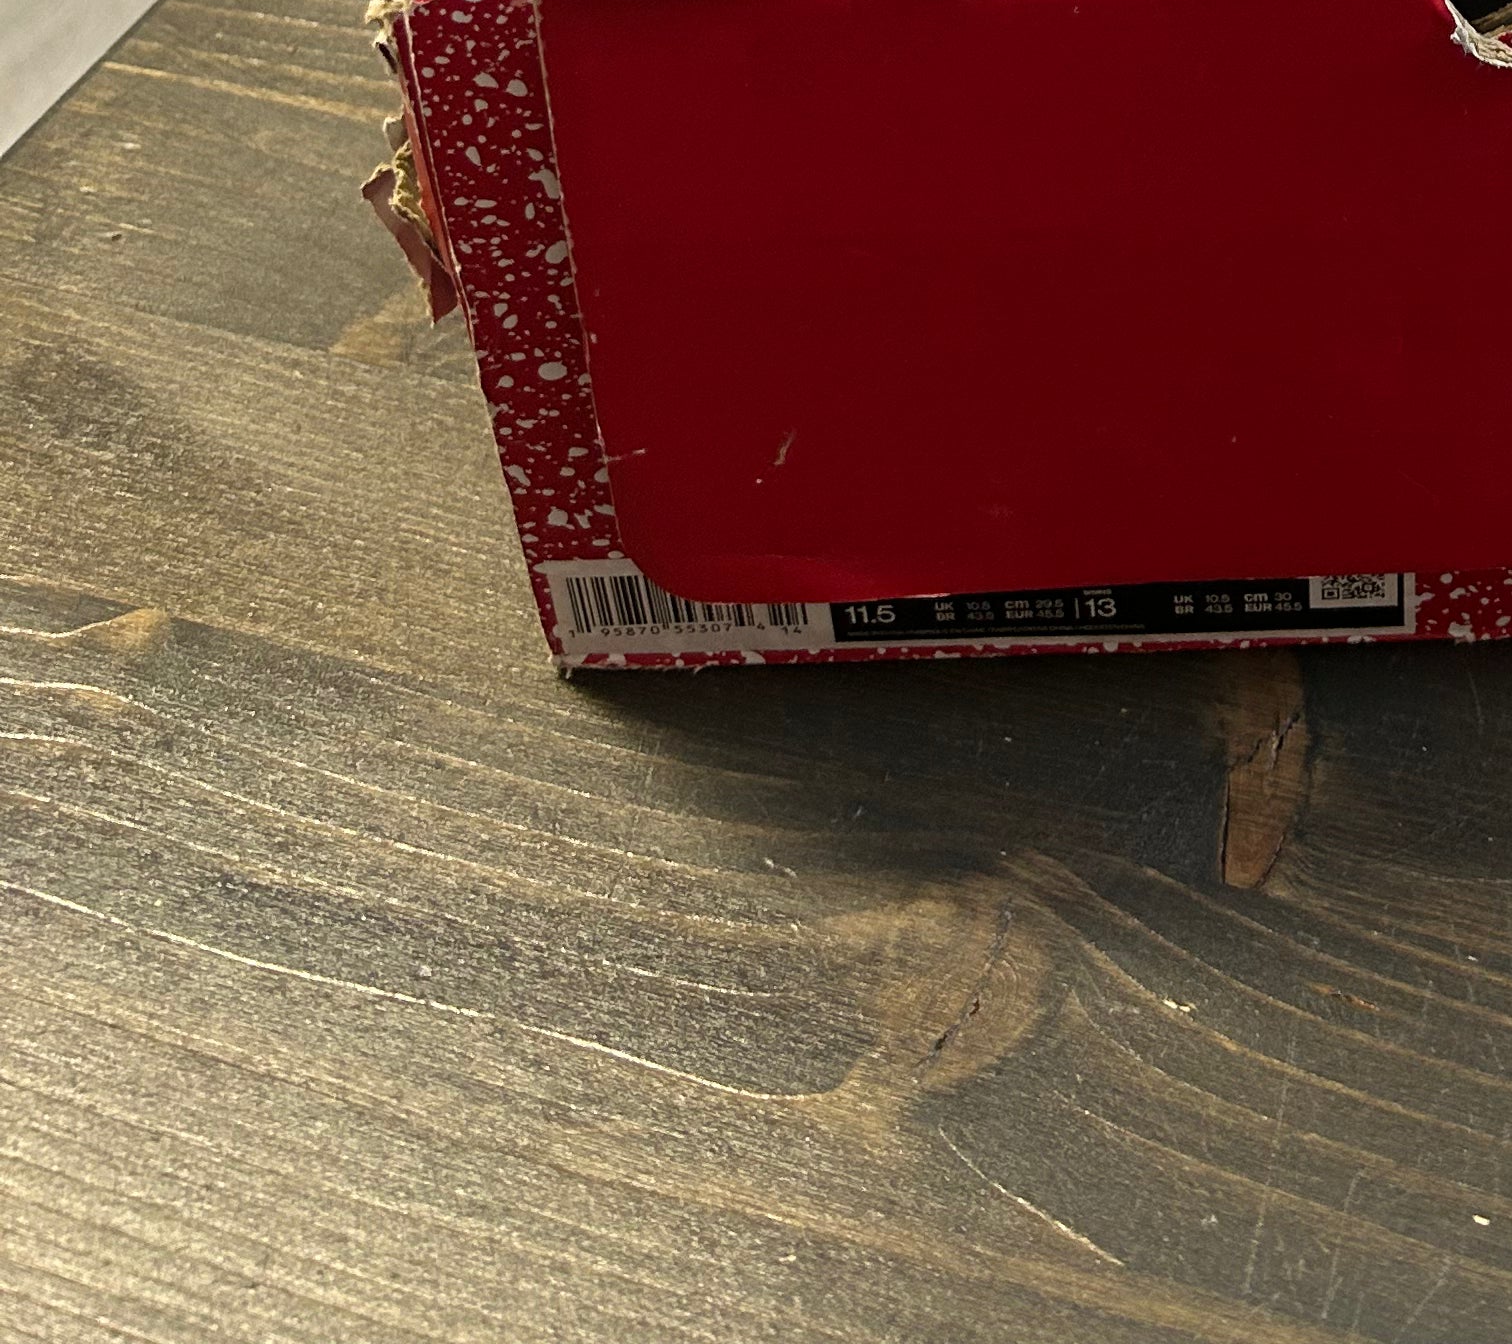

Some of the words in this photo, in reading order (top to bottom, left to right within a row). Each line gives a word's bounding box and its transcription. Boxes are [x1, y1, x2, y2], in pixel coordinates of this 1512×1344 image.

[1173, 594, 1193, 604] UK
[1244, 592, 1269, 602] cm
[1274, 591, 1292, 602] 30
[1004, 600, 1030, 610] cm
[1085, 597, 1117, 619] 13
[1244, 602, 1272, 613] EUR
[845, 604, 896, 625] 11.5
[1005, 610, 1033, 620] EUR
[600, 625, 661, 637] 95870
